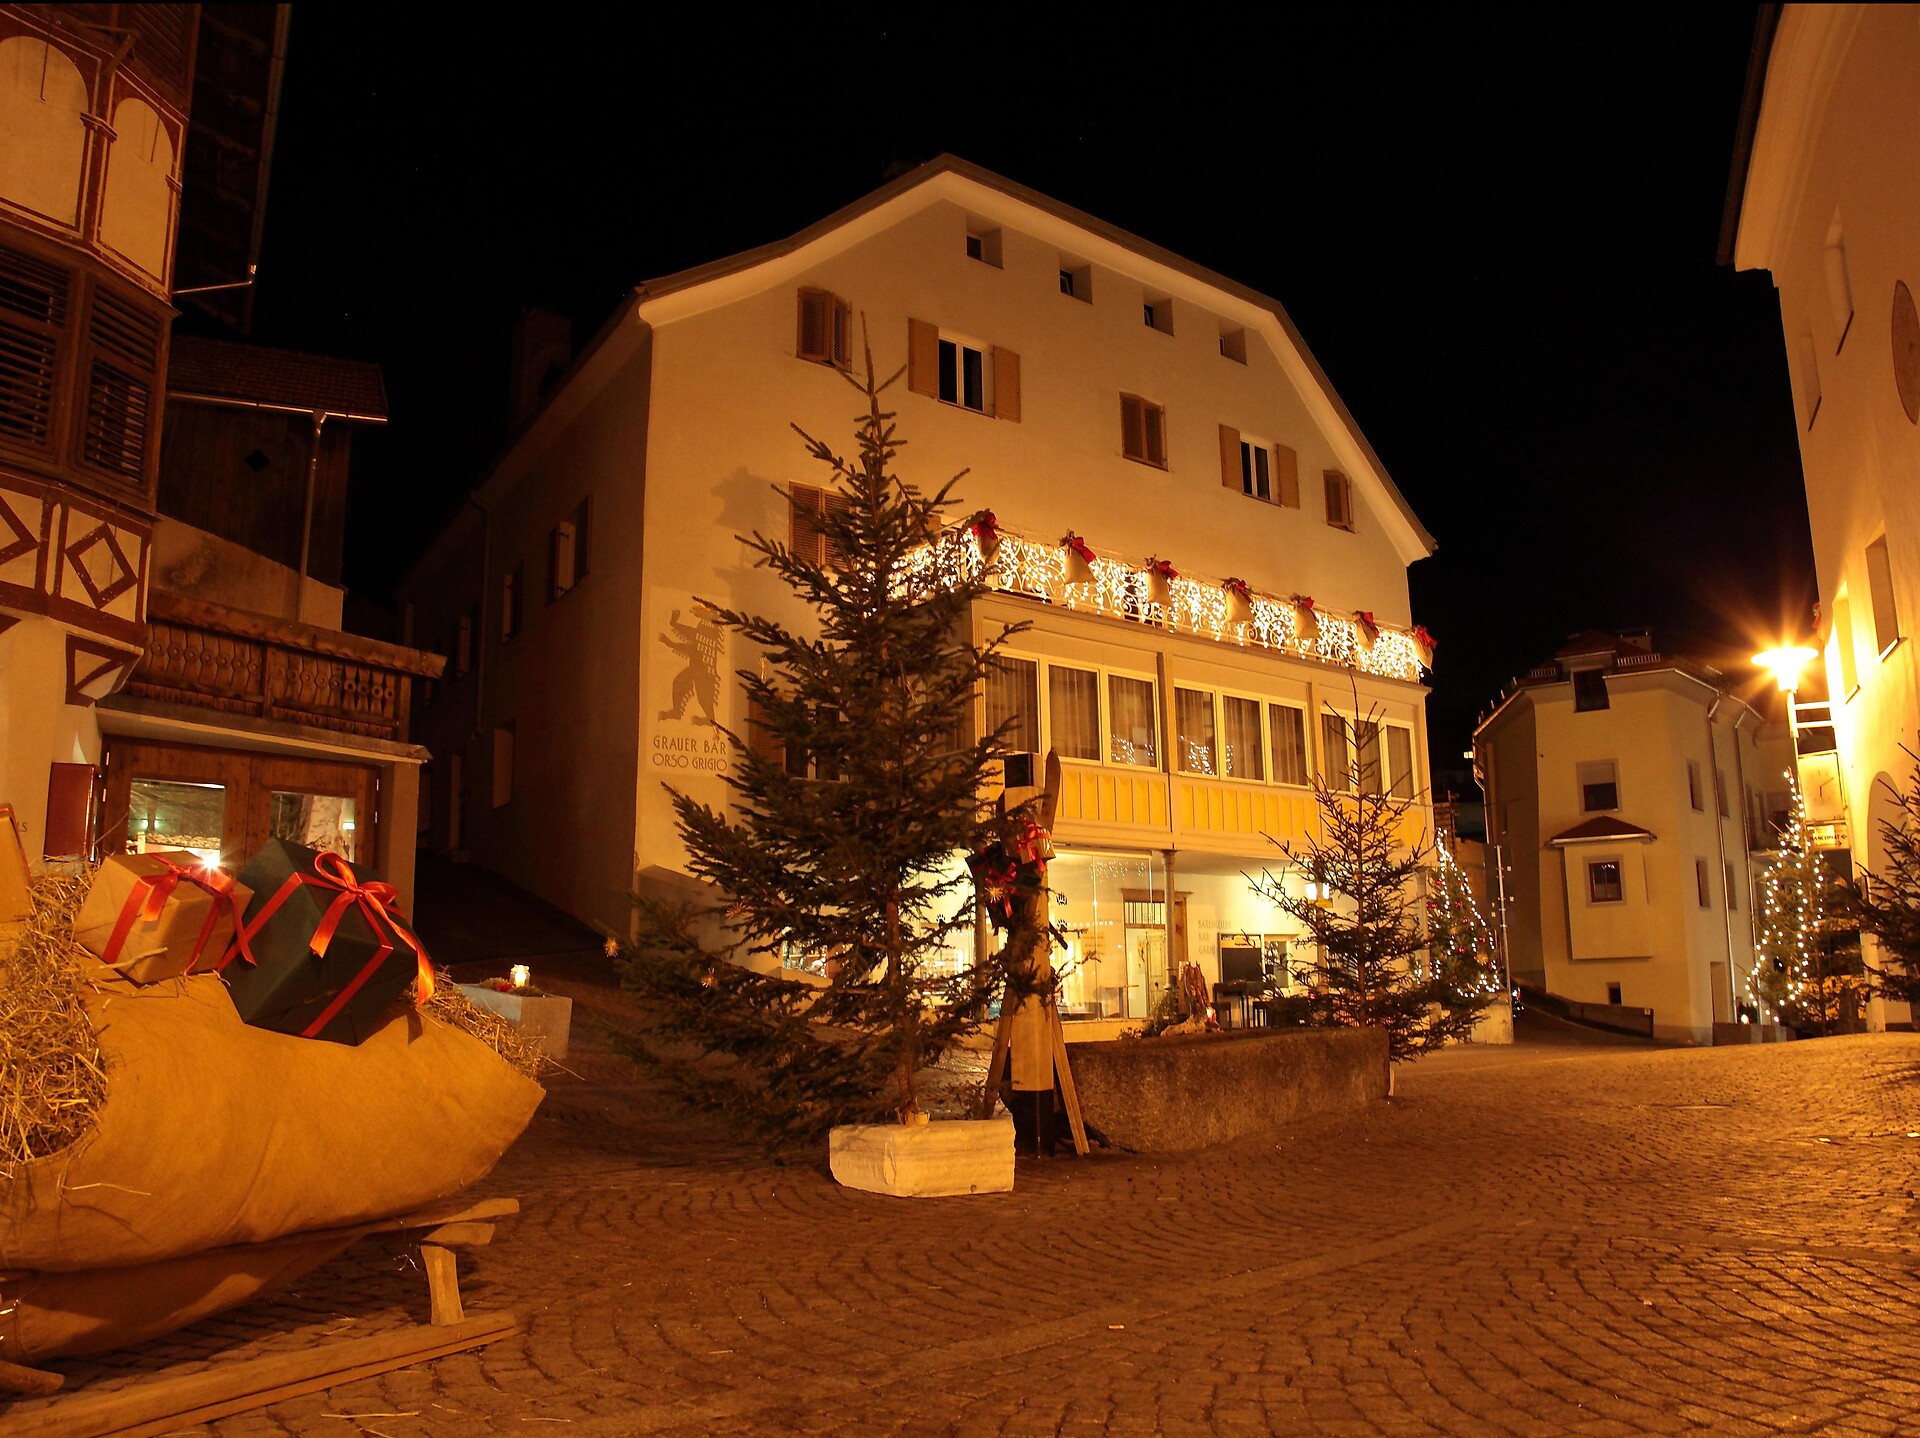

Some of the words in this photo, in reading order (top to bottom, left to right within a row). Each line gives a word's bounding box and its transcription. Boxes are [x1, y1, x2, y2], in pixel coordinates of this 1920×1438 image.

[653, 735, 698, 753] GRAUER
[652, 753, 689, 769] ORSO
[691, 757, 728, 772] GRIGIO
